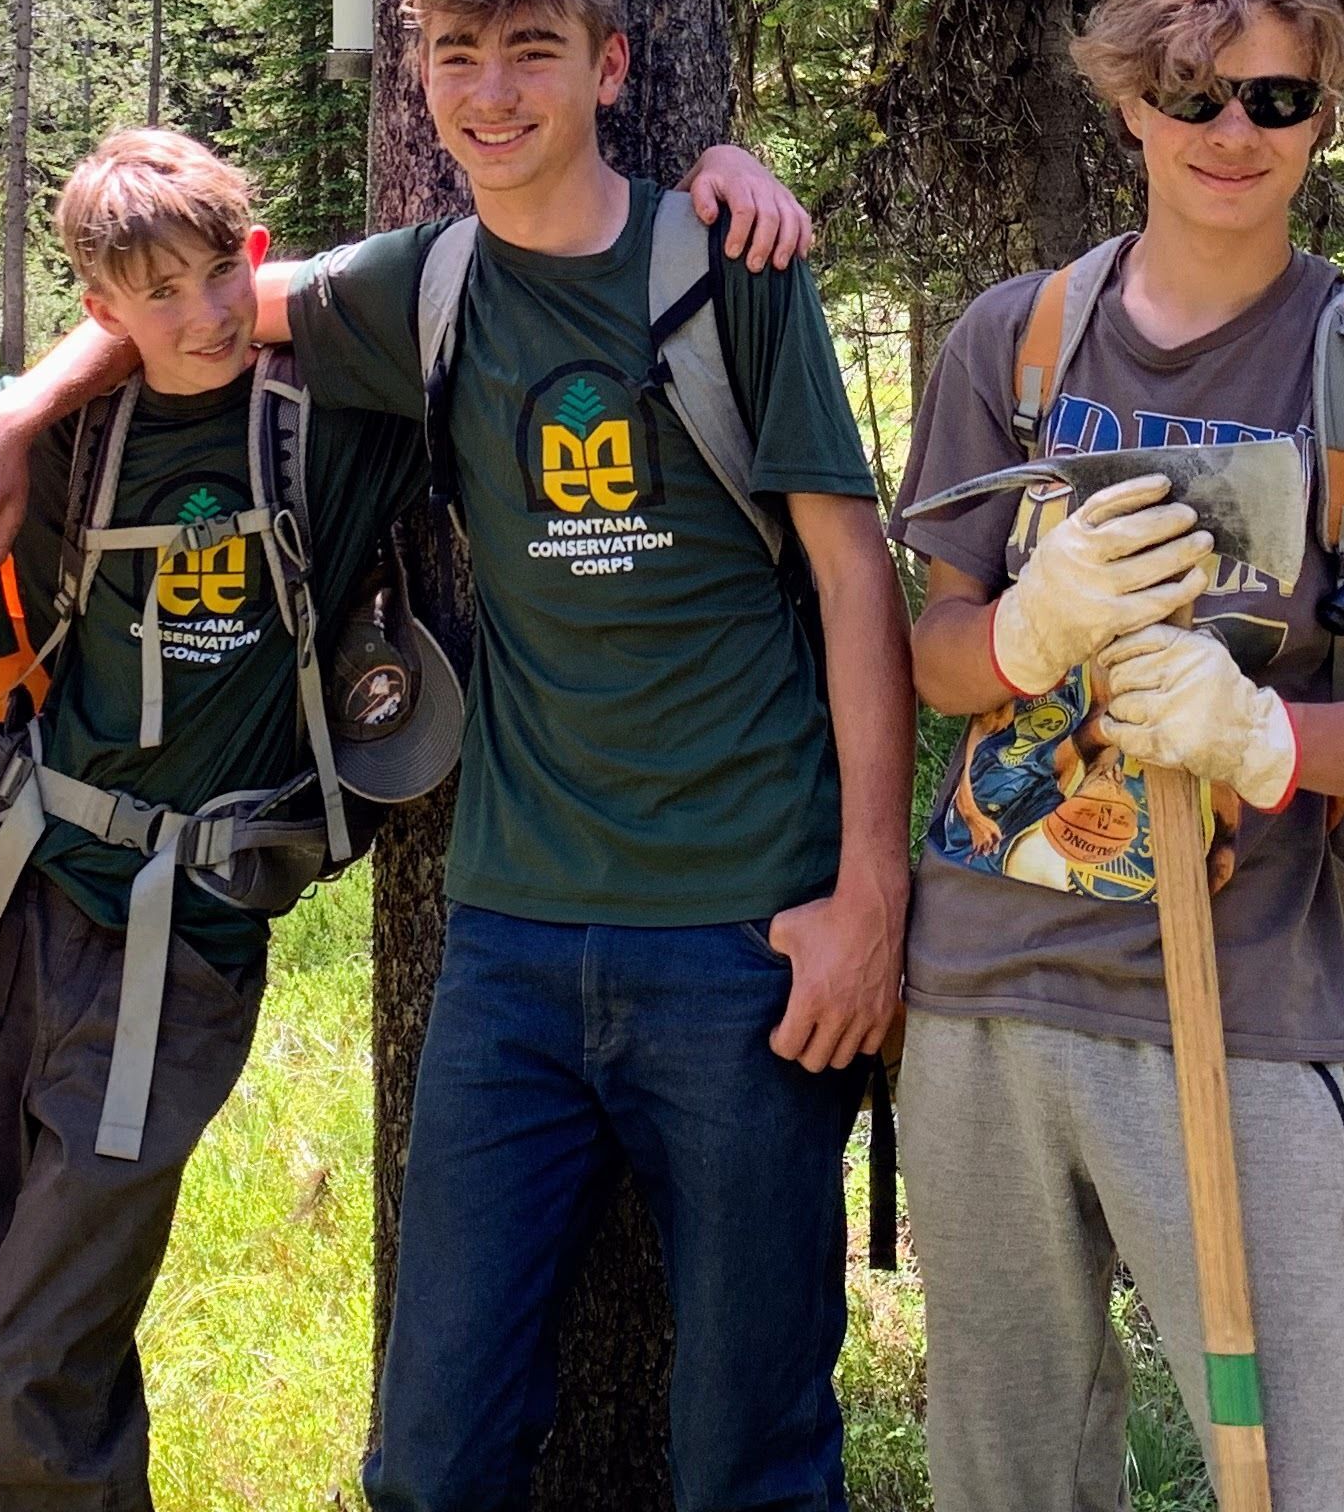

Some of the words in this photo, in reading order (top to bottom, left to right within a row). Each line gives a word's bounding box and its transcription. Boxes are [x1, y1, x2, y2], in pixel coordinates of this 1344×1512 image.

[548, 516, 648, 535] MONTANA
[528, 532, 673, 559] CONSERVATION
[571, 555, 634, 576] CORPS
[158, 618, 244, 634] NTANA
[130, 629, 261, 651] CSERVATION
[162, 646, 222, 665] CORPS
